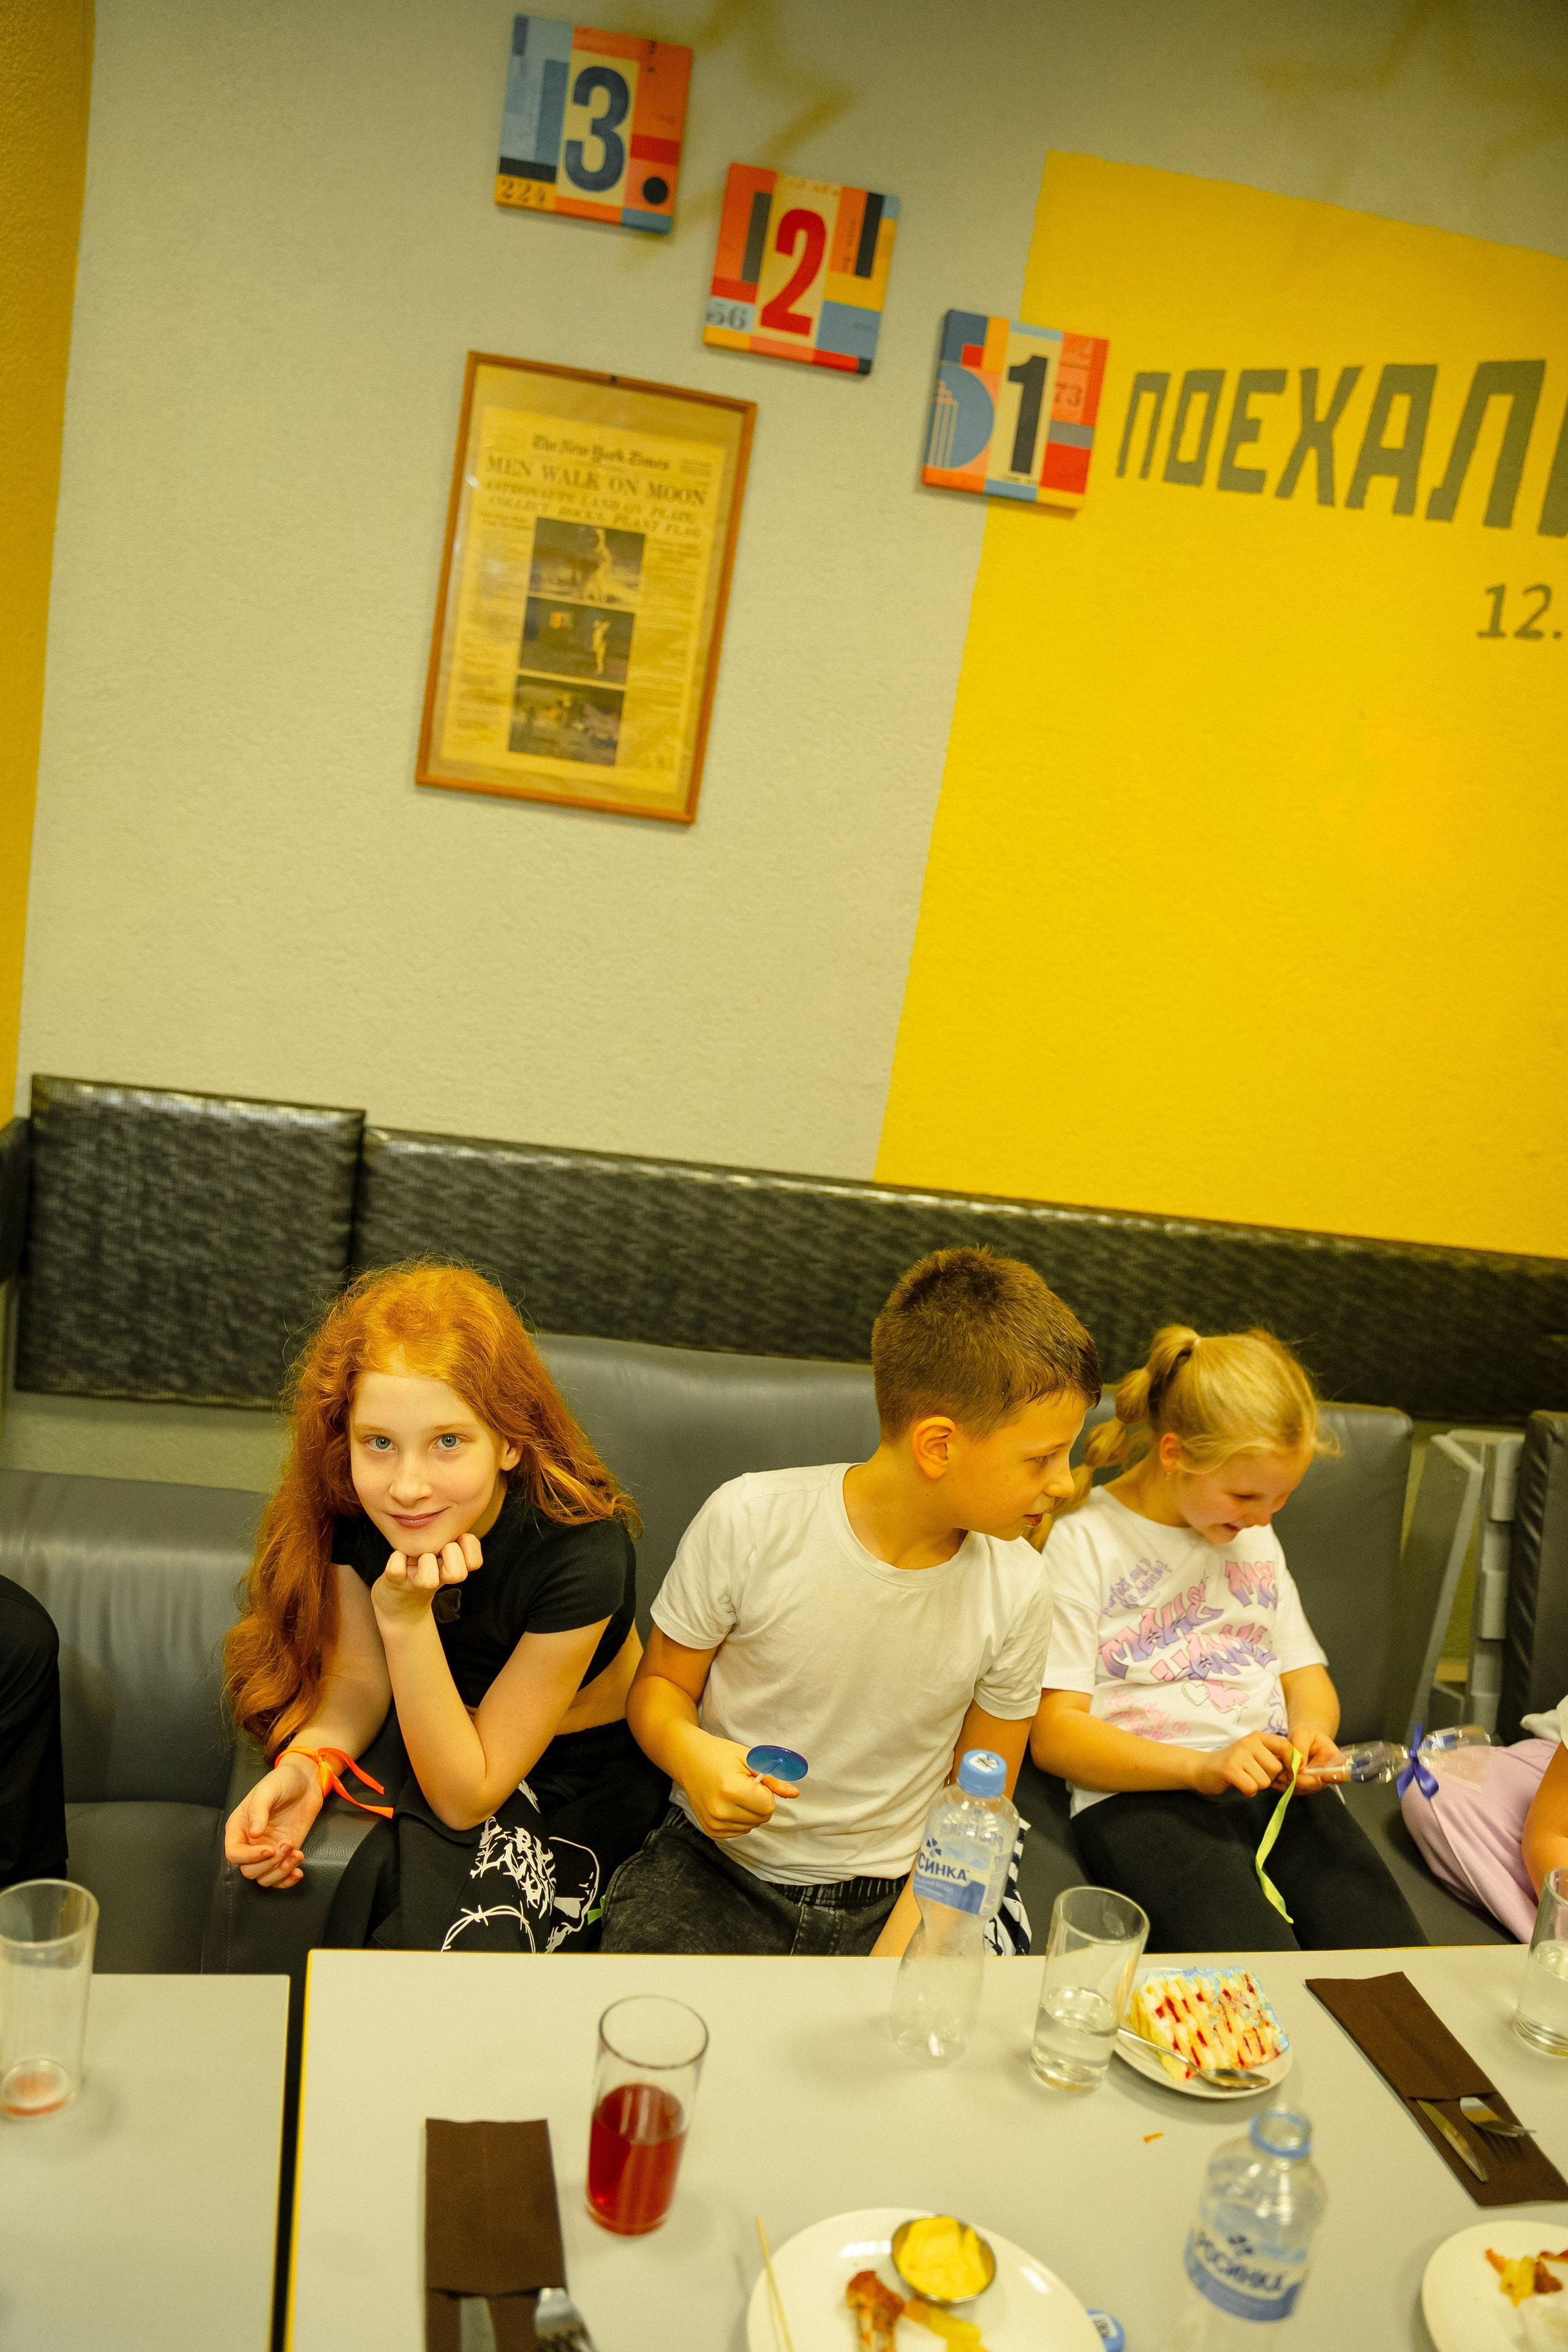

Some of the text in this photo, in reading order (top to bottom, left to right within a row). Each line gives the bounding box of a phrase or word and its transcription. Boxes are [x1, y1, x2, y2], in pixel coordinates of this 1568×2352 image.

[564, 66, 631, 194] 3
[760, 208, 827, 338] 2
[1008, 354, 1049, 475] 1
[487, 455, 707, 507] MEN WALK ON MOON
